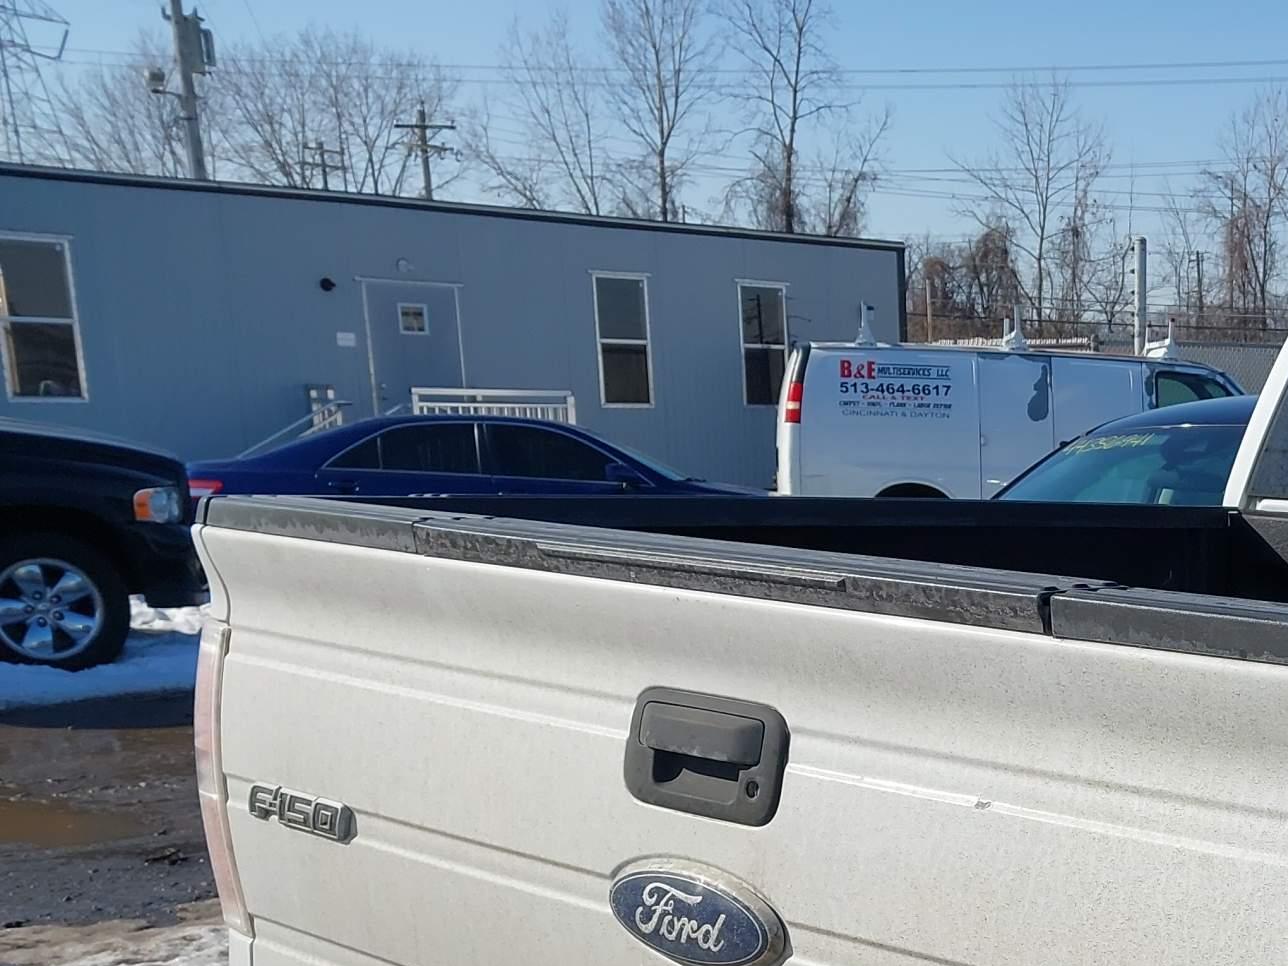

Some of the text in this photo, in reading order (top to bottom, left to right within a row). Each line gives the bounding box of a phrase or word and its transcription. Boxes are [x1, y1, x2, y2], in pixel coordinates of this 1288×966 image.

[877, 366, 932, 377] MULTISERVICES
[936, 368, 950, 378] LLC
[840, 381, 952, 396] 513-464-6617
[842, 408, 898, 418] CINCINNATI
[910, 410, 951, 419] DAYTON
[635, 882, 726, 953] Ford
